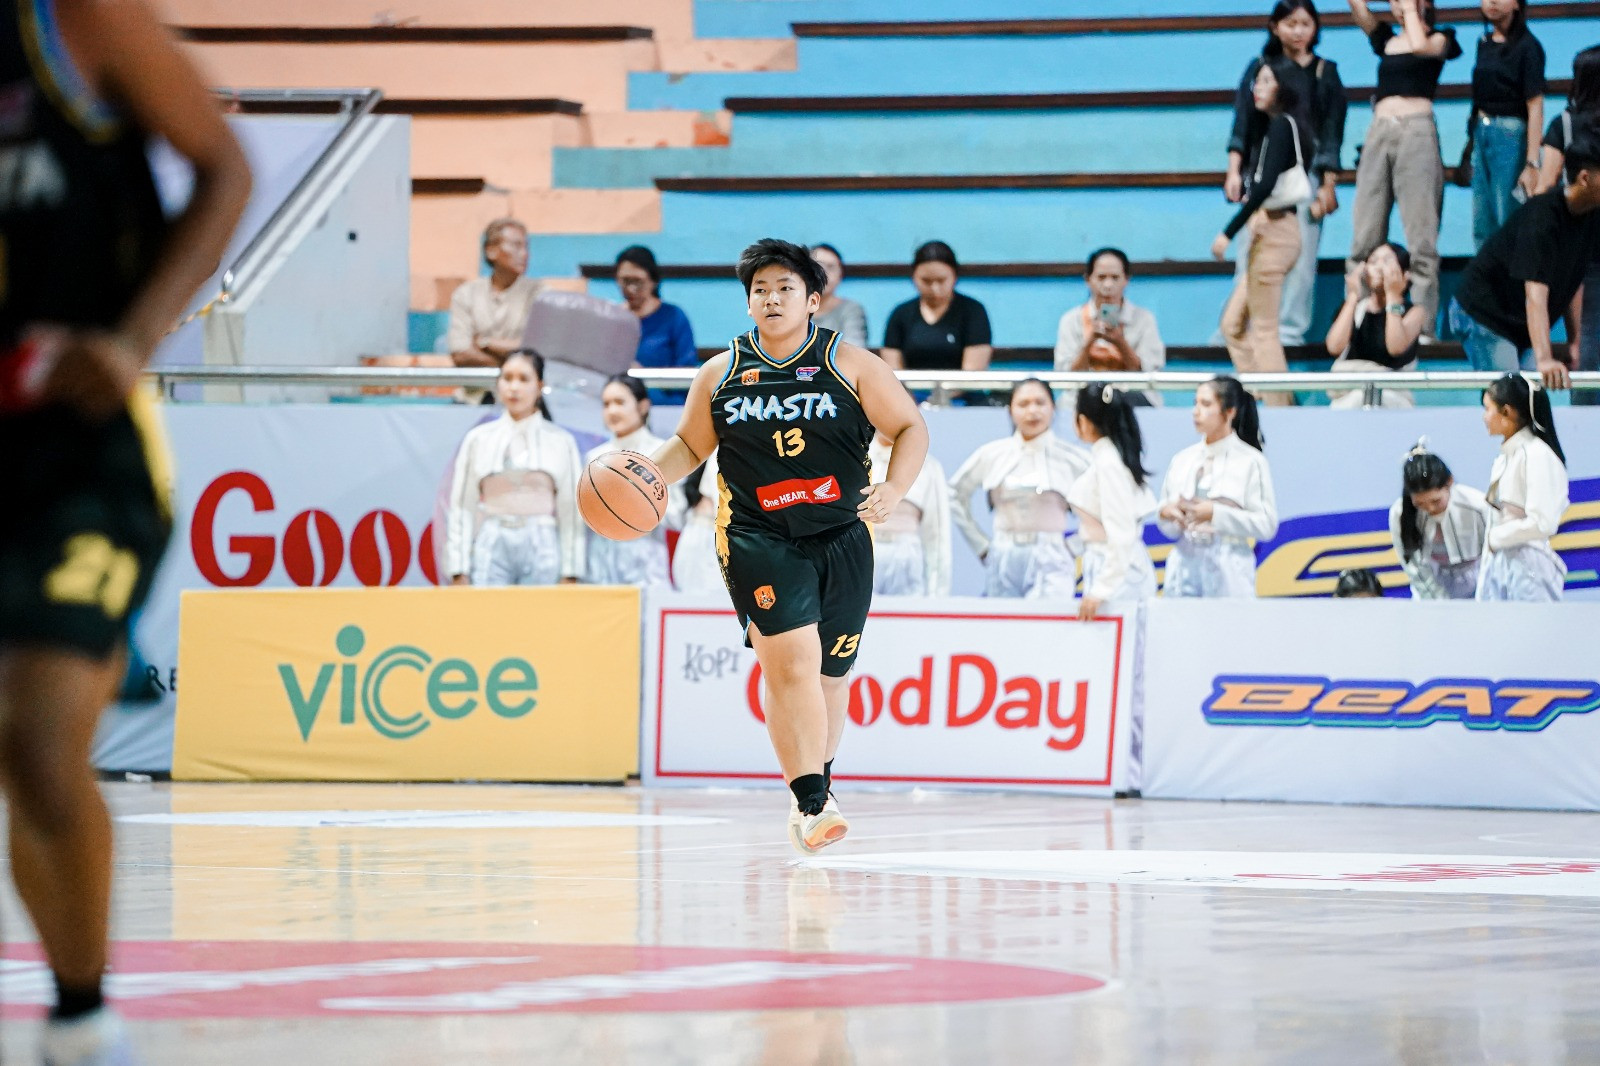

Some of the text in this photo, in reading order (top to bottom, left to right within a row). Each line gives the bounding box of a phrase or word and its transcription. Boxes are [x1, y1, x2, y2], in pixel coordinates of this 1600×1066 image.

[723, 392, 838, 425] SMASTA
[772, 428, 805, 457] 13
[763, 499, 780, 508] One
[830, 634, 860, 658] 13
[946, 654, 1089, 751] Day
